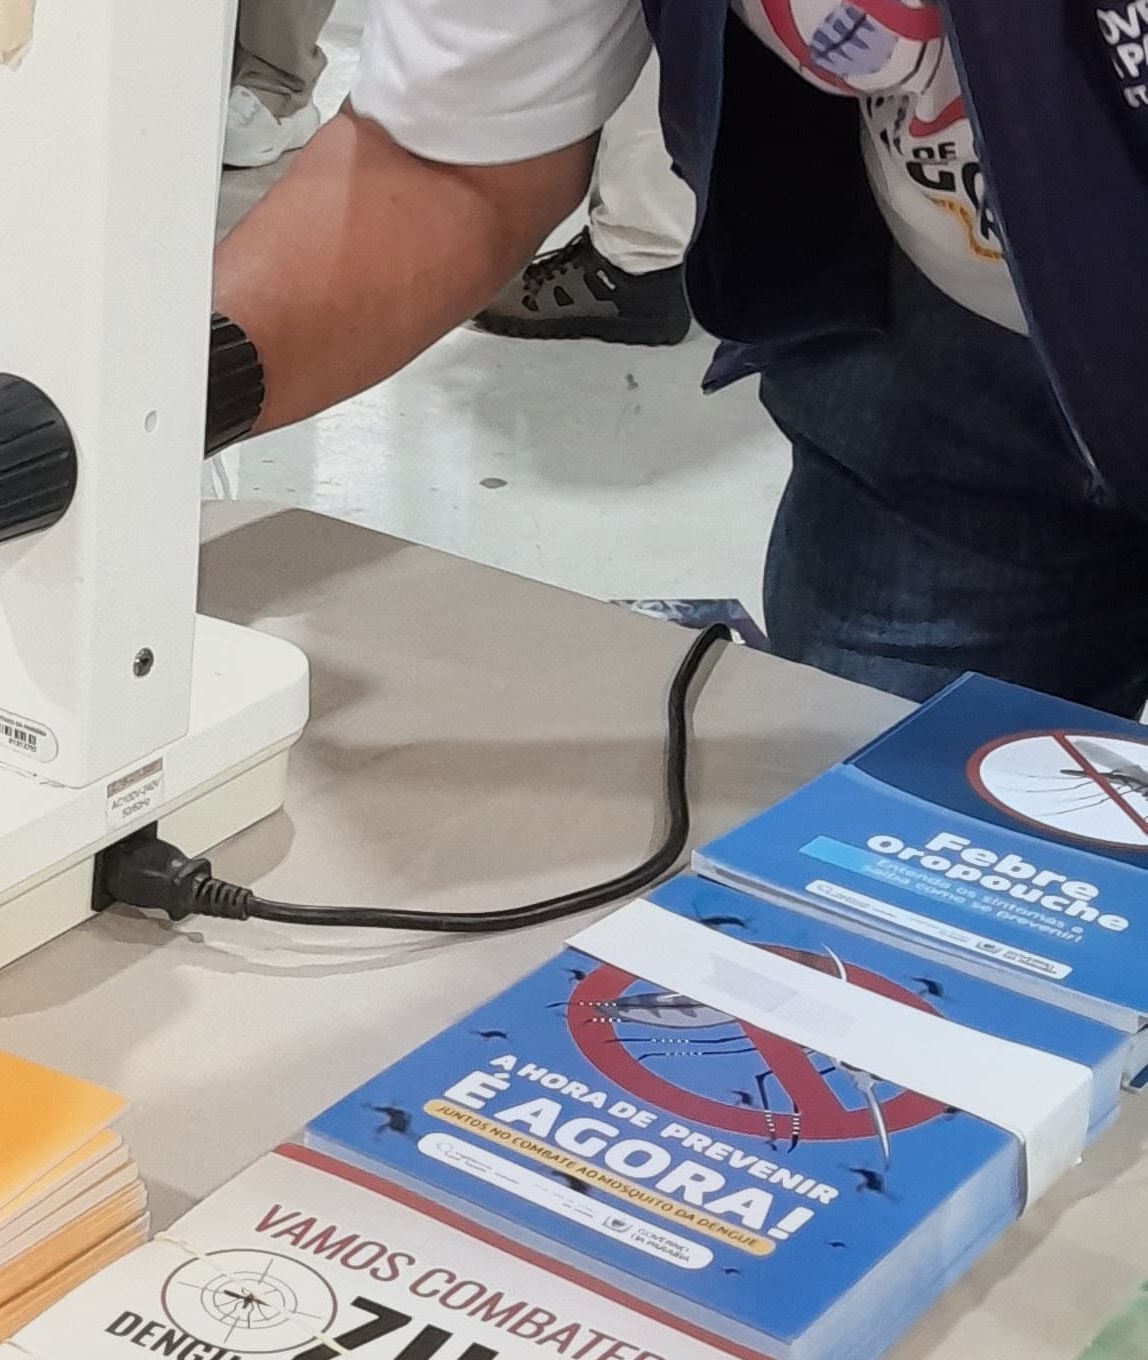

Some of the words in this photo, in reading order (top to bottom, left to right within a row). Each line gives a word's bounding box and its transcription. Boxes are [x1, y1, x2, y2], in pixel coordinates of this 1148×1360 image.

[866, 834, 1130, 932] Oropouche
[924, 831, 1100, 902] Febre
[437, 1104, 488, 1131] JUNTOS
[489, 1127, 512, 1140] NO
[512, 1137, 578, 1170] COMBATE
[577, 1163, 599, 1179] AO
[596, 1174, 674, 1213] MOSQUITO
[674, 1207, 696, 1222] DA
[696, 1217, 760, 1248] DENGUE
[444, 1070, 512, 1110] É
[494, 1096, 816, 1242] AGORA!
[489, 1053, 518, 1072] A
[516, 1063, 605, 1110] HORA
[607, 1100, 659, 1129] DE
[659, 1122, 840, 1205] PREVENIR
[253, 1203, 416, 1283] VAMOS
